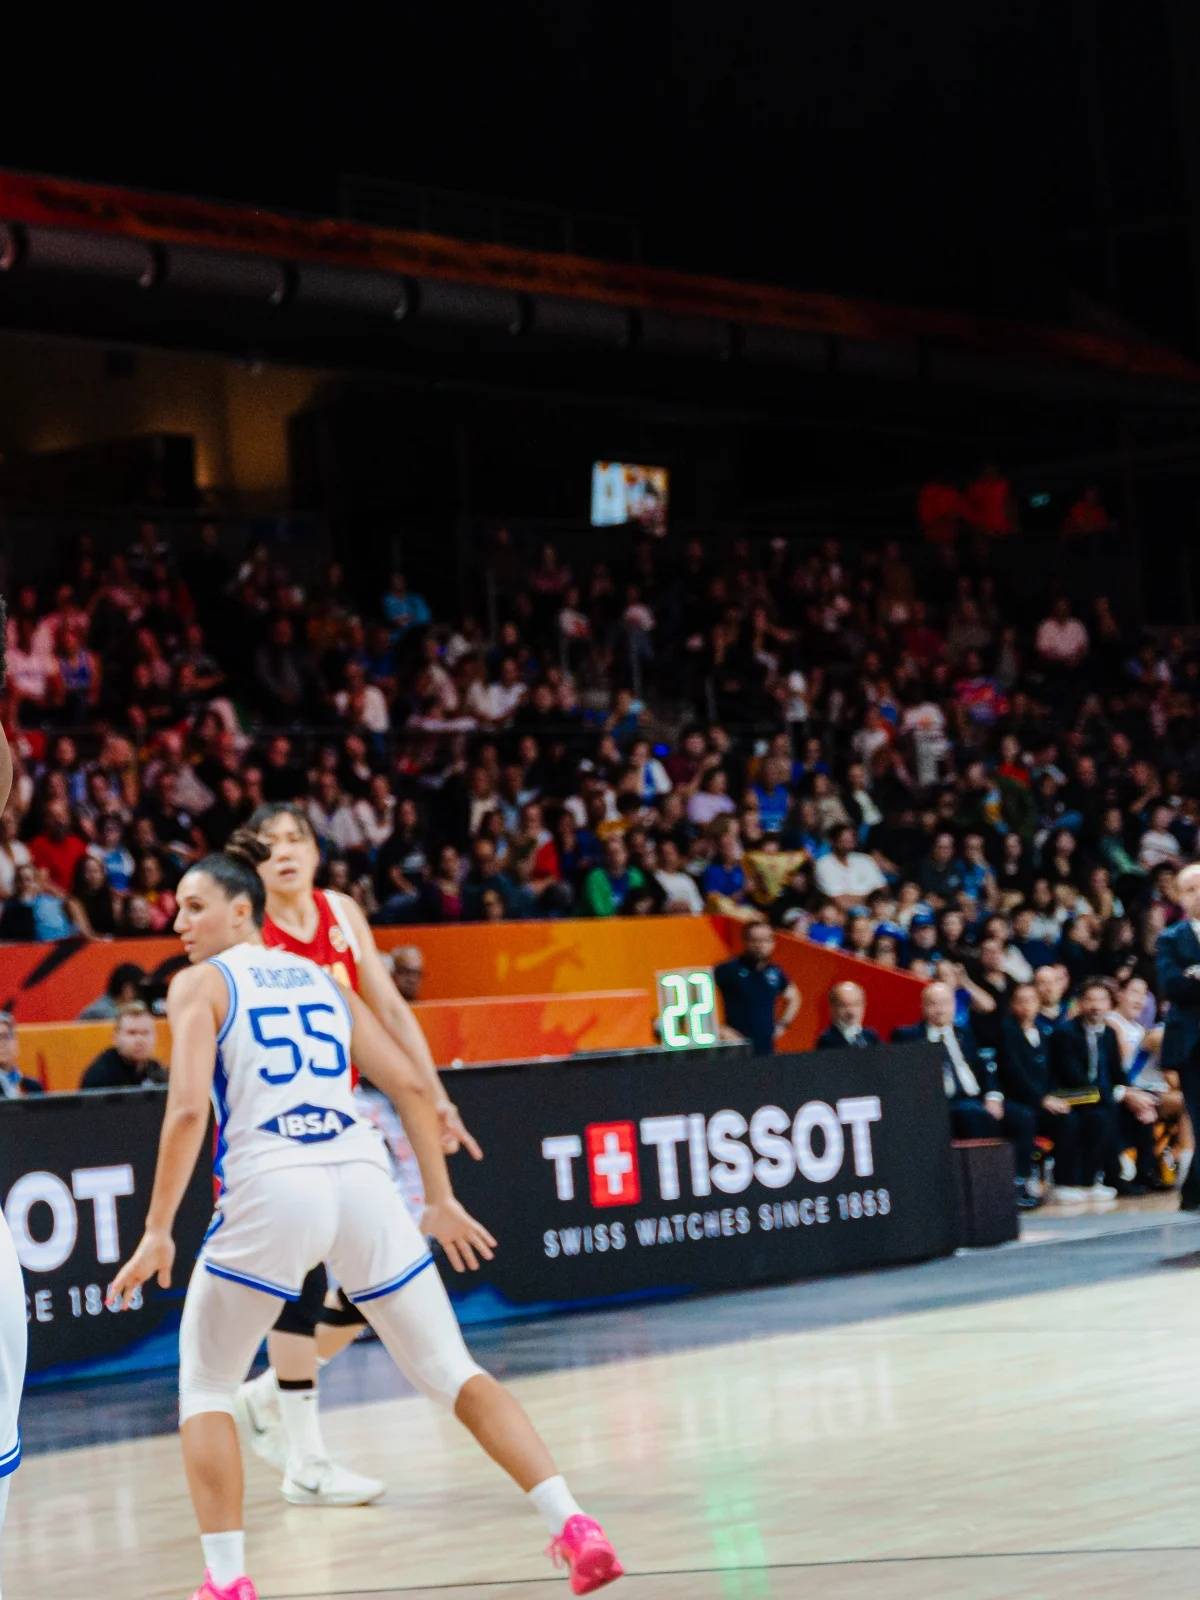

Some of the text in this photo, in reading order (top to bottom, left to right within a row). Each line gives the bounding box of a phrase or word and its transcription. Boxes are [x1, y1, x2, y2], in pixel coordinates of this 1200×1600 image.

[247, 1003, 348, 1086] 55
[660, 972, 715, 1047] 22
[276, 1109, 344, 1138] IBSA
[639, 1095, 883, 1202] TISSOT
[4, 1163, 136, 1273] OT
[543, 1221, 627, 1260] SWISS
[633, 1205, 751, 1248] WATCHES
[757, 1195, 831, 1232] SINCE
